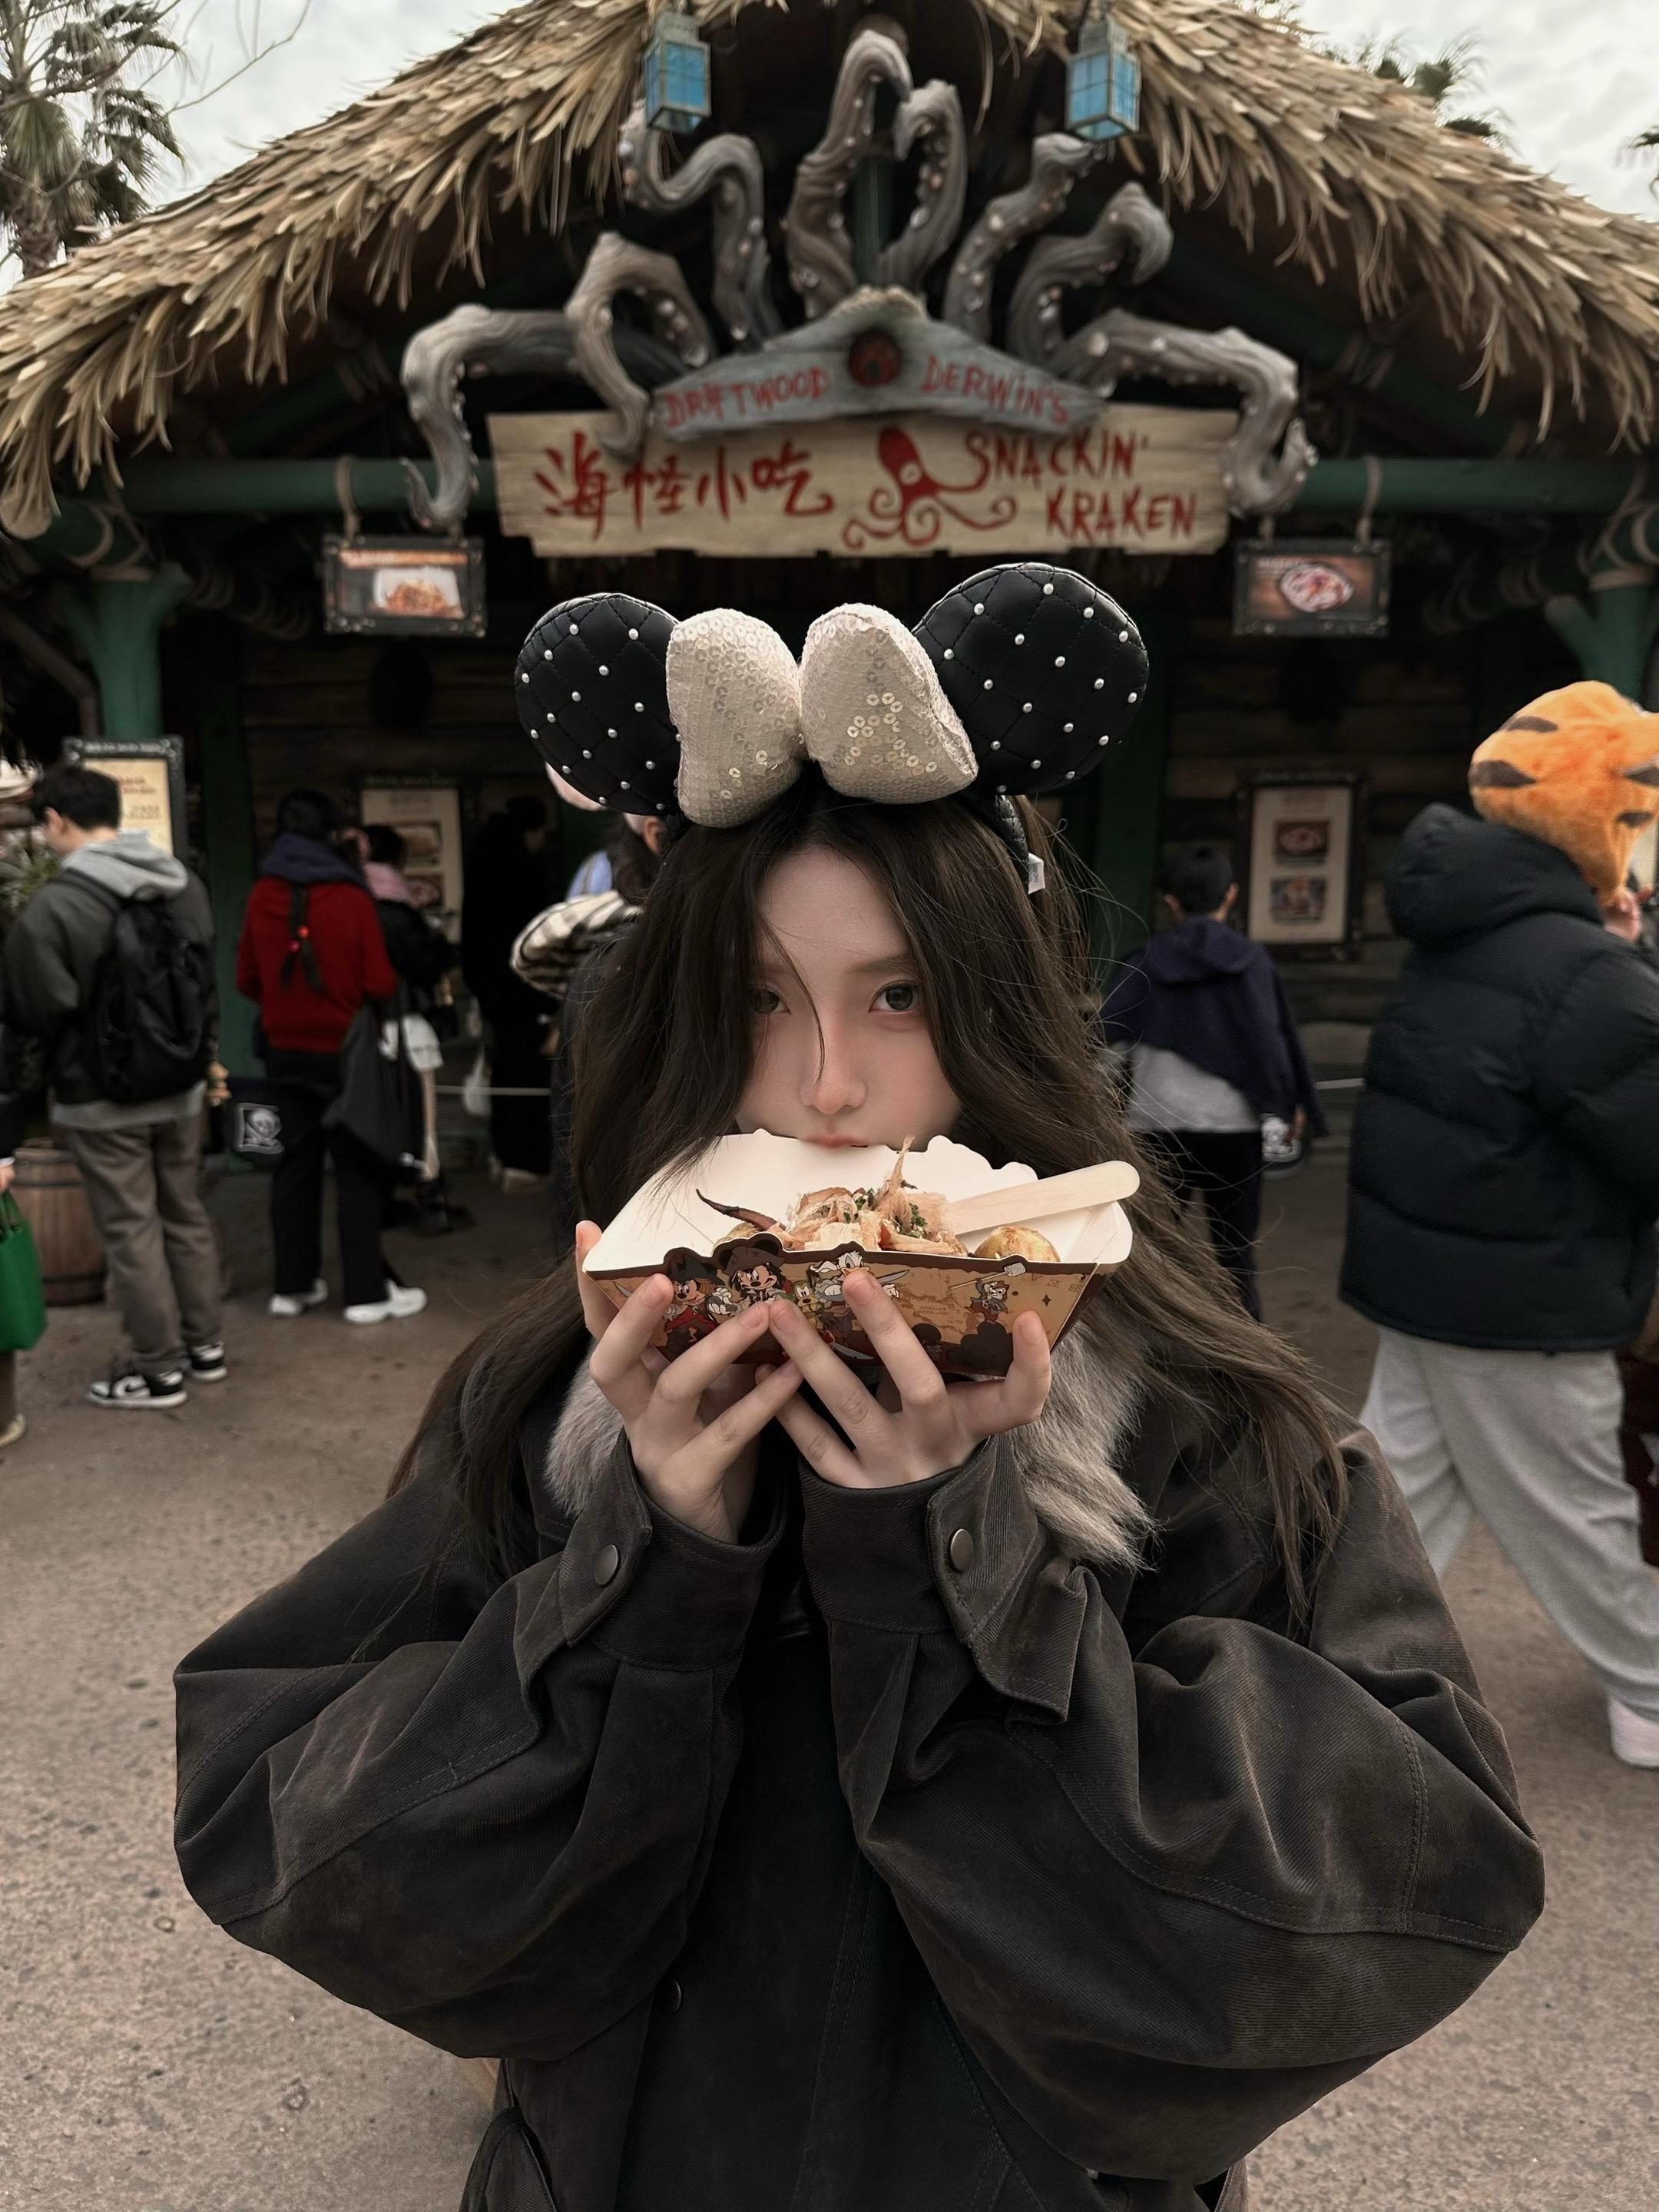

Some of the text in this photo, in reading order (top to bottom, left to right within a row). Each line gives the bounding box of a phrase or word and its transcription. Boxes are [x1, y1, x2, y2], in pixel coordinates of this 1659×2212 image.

[535, 431, 835, 542] 海怪小吃
[965, 426, 1150, 490] SNACKIN'
[1045, 484, 1198, 545] KRAKEN
